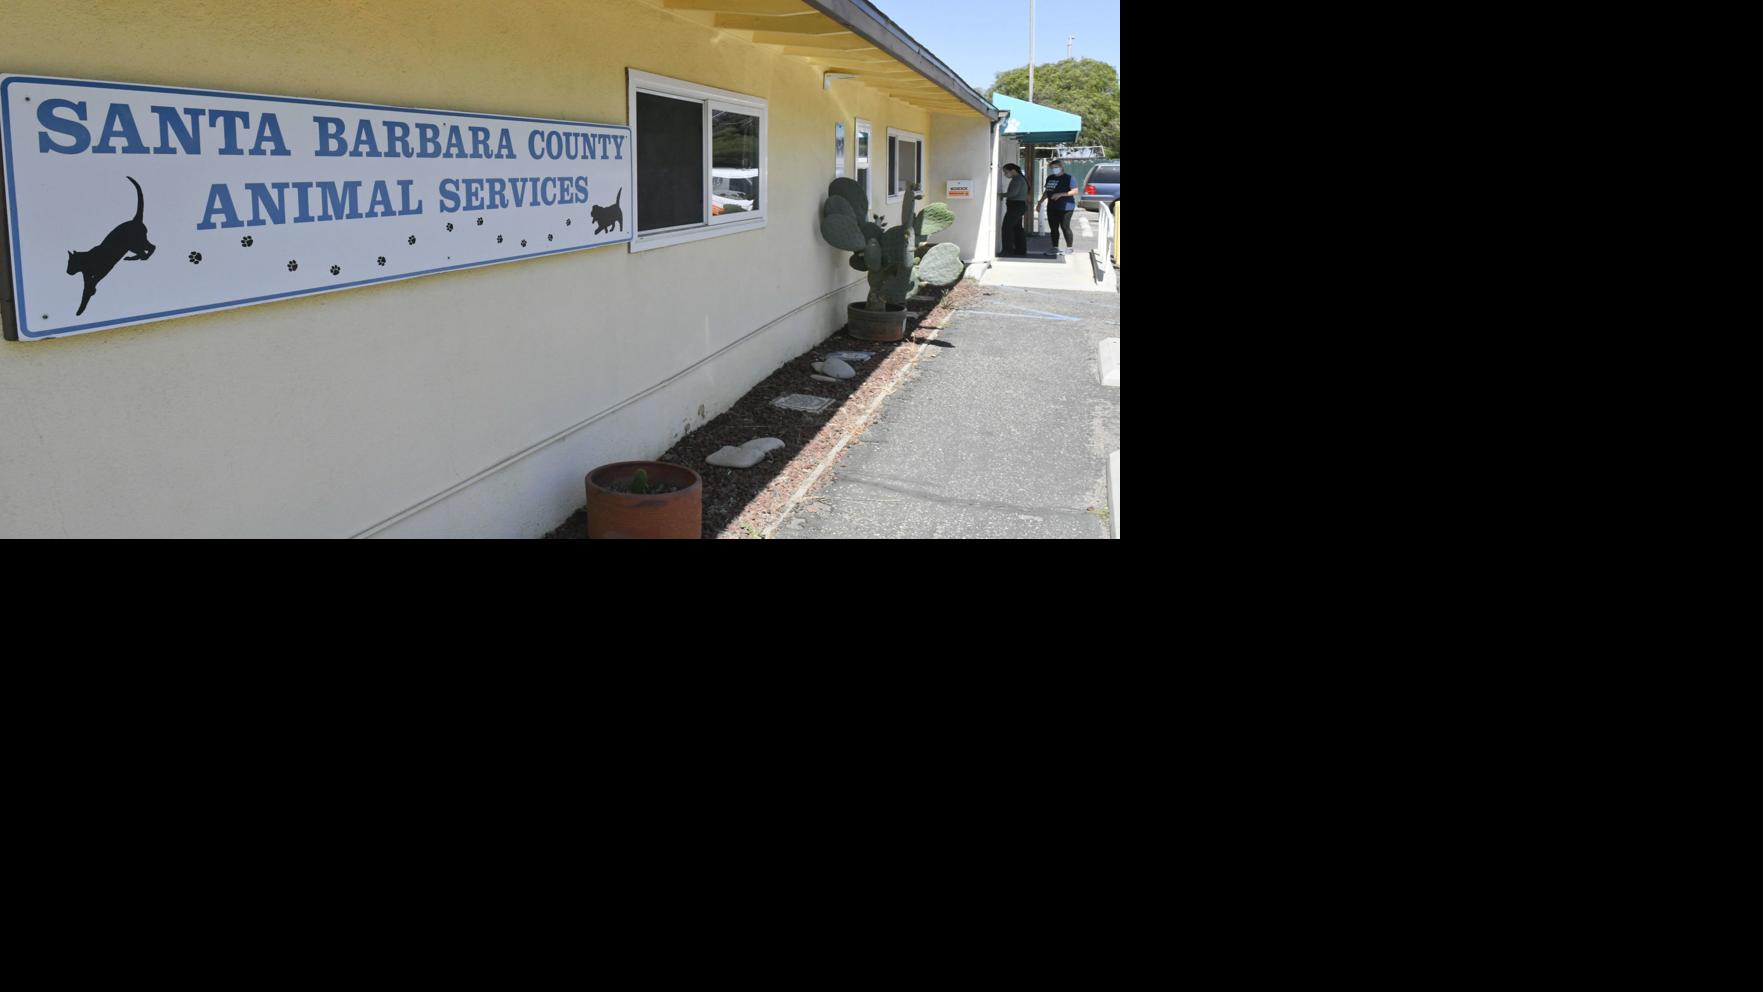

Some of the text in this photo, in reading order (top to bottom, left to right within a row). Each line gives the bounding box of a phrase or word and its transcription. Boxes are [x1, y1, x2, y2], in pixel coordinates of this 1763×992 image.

[36, 98, 625, 160] SANTA BARBARA COUNTY
[196, 176, 589, 231] ANIMAL SERVICES
